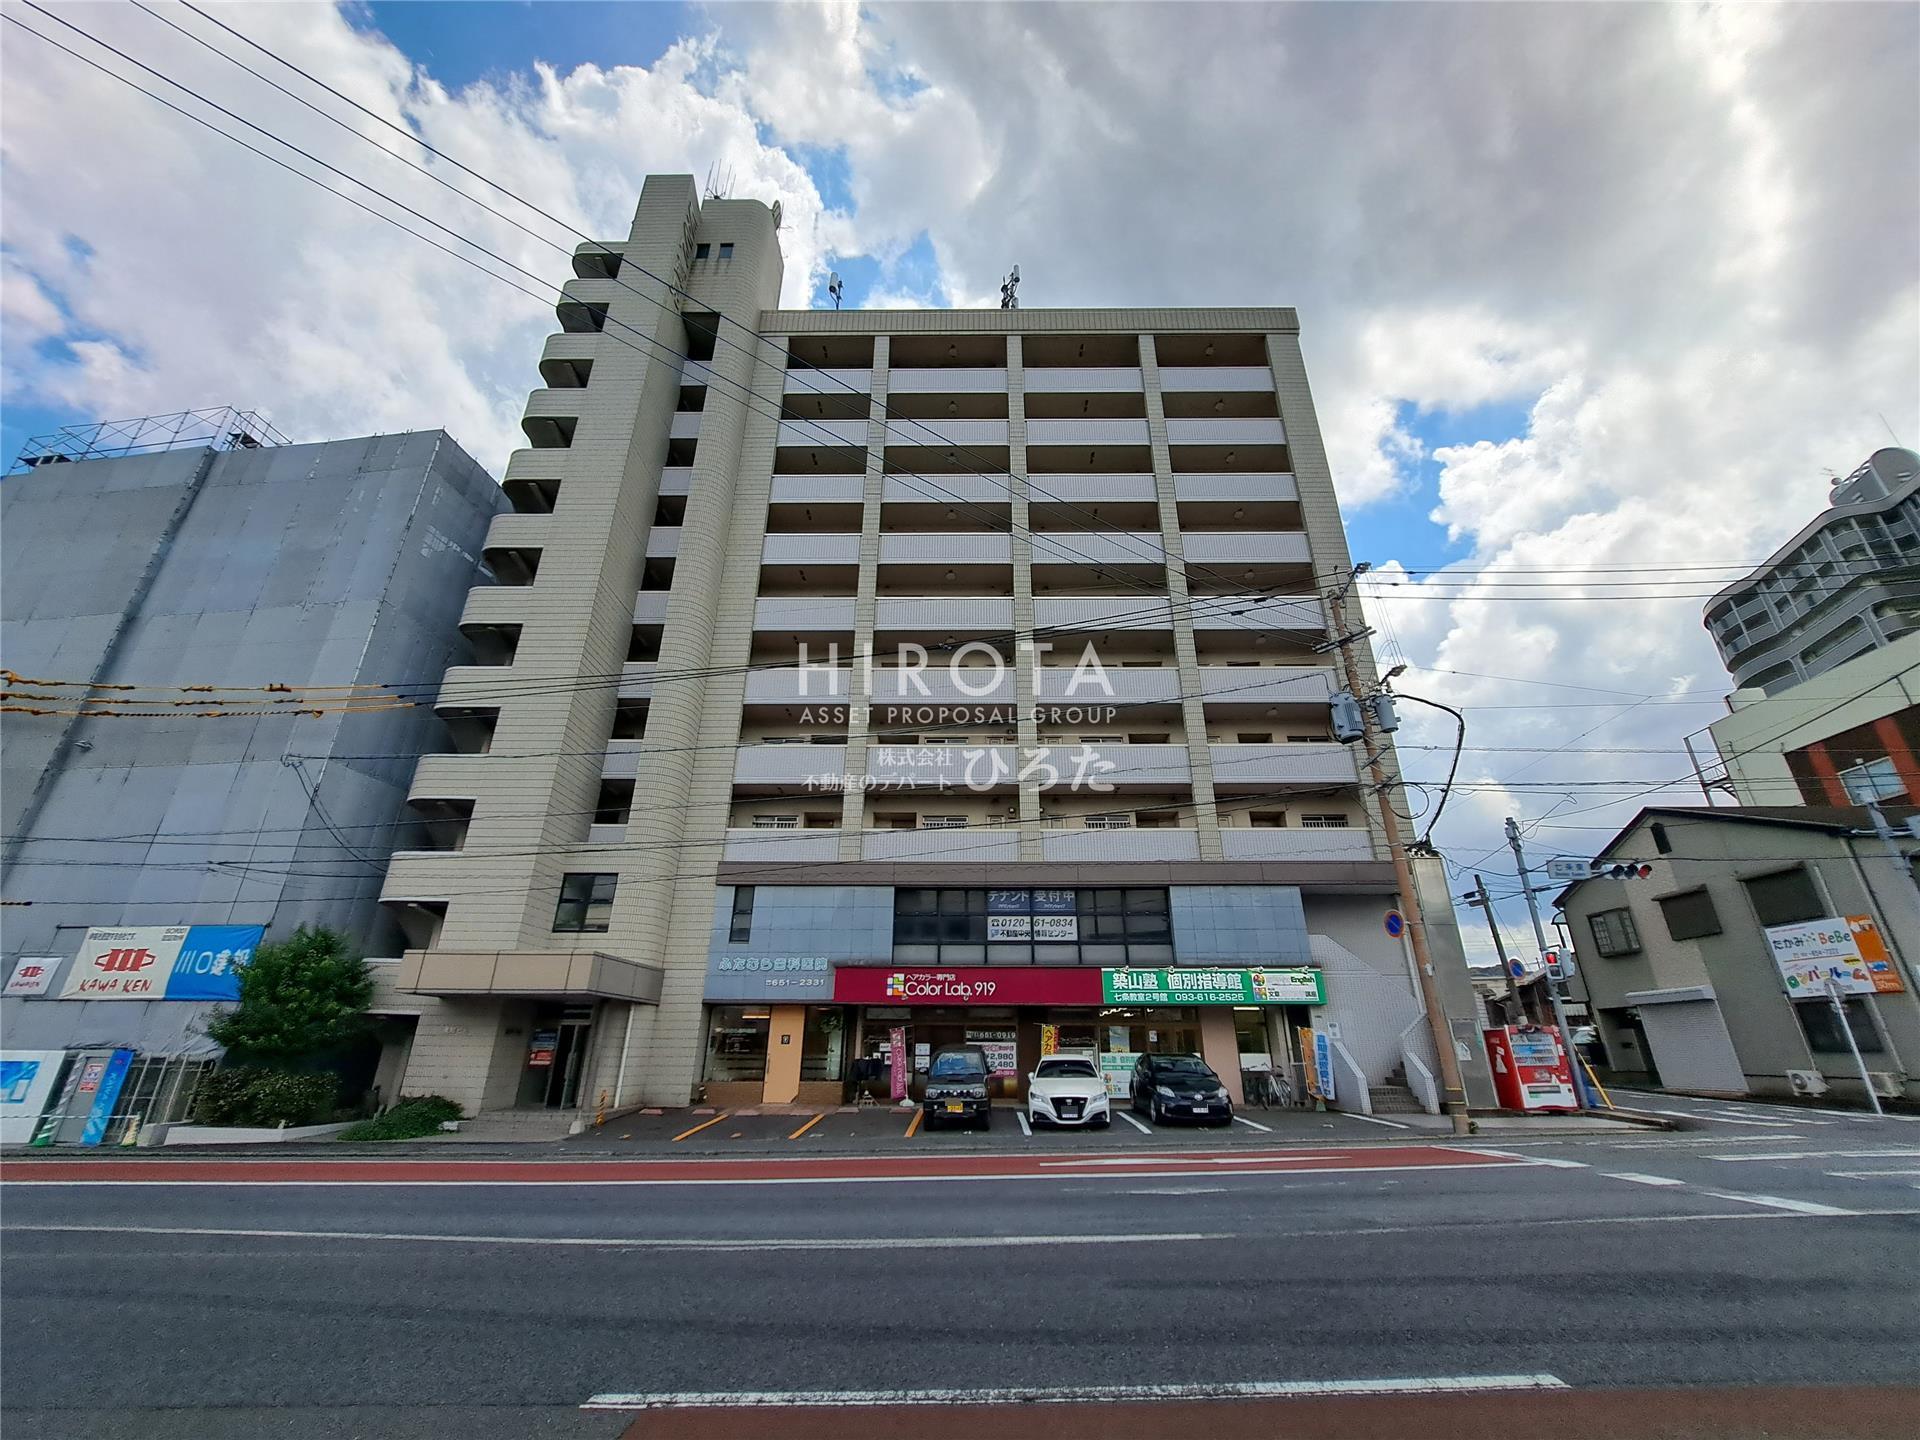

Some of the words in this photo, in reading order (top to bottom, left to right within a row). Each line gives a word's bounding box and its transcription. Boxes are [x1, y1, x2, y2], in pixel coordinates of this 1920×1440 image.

[1818, 930, 1852, 945] BeBe
[79, 979, 117, 992] KAWA
[123, 979, 153, 993] KEN
[1167, 972, 1243, 990] 個別指導館
[904, 981, 943, 997] Color
[975, 981, 996, 997] 919
[1174, 992, 1245, 1002] 093-616-2525
